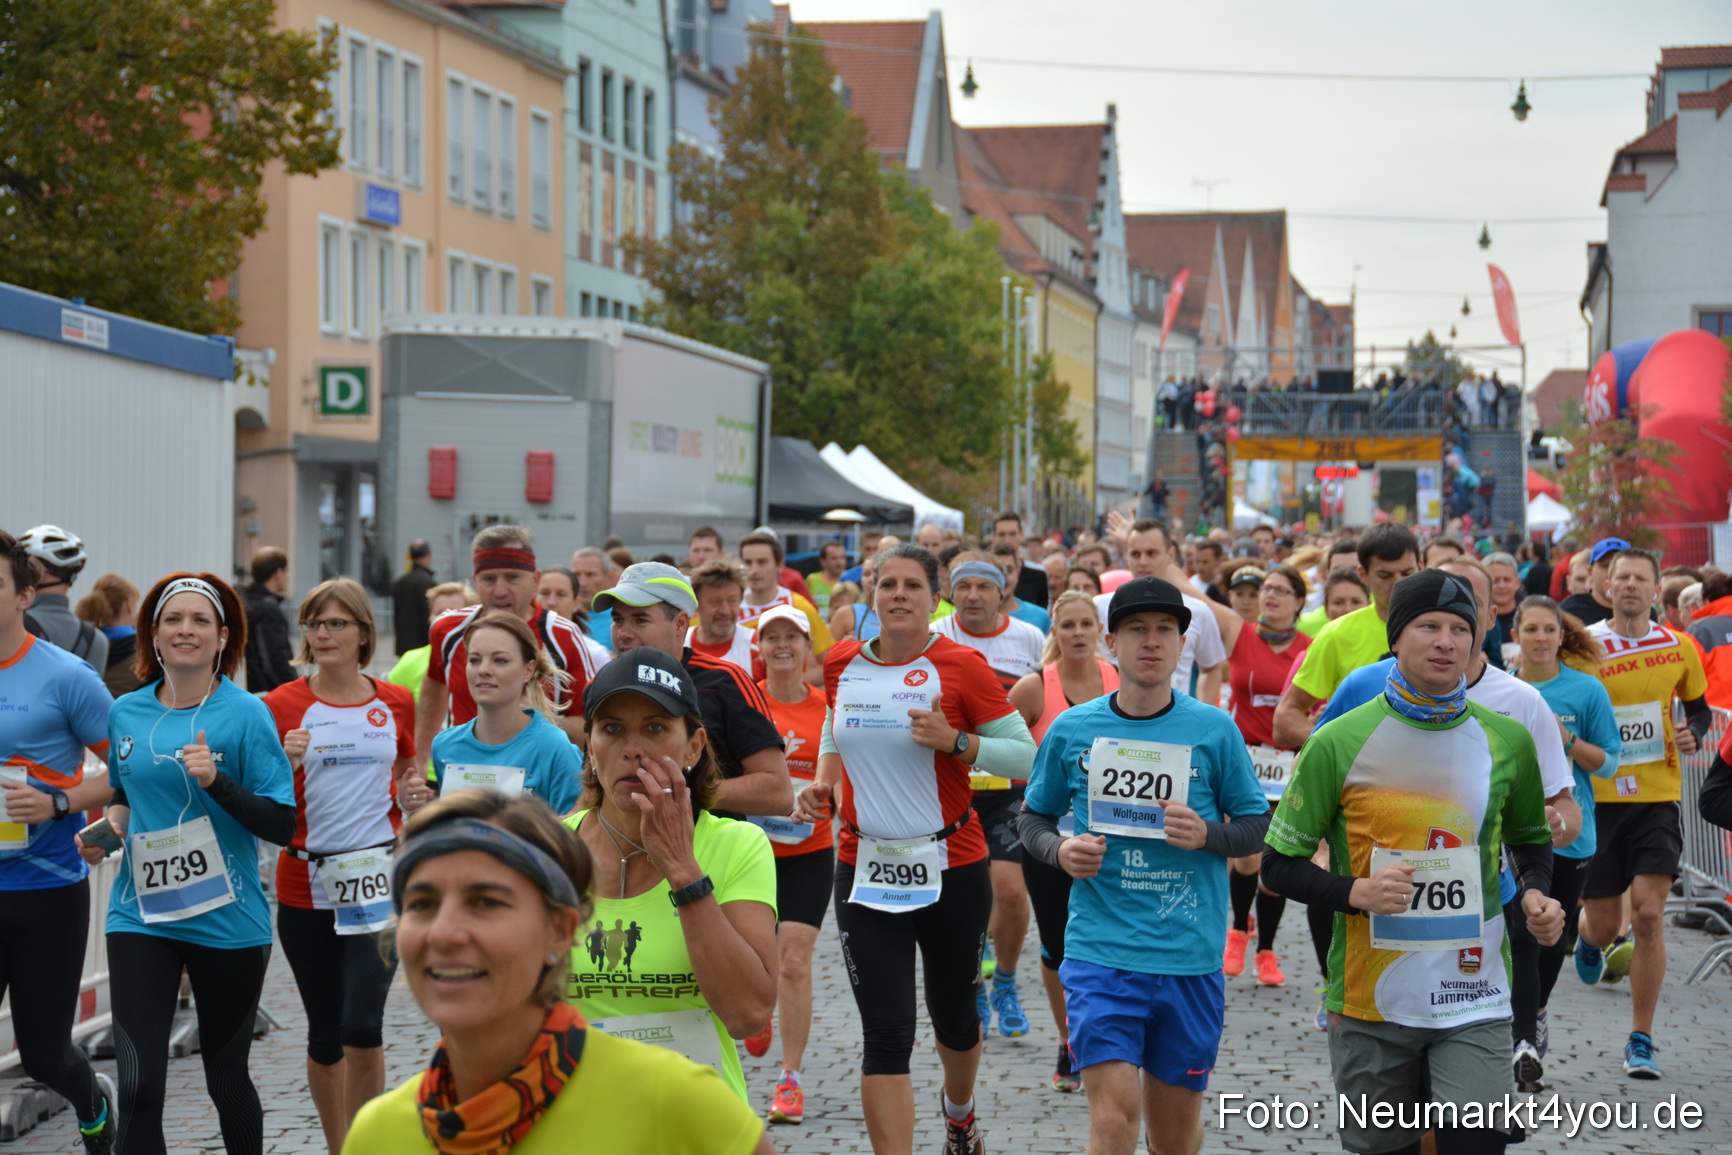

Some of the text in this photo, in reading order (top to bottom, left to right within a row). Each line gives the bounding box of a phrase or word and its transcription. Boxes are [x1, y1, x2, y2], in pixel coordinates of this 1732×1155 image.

[326, 372, 364, 410] D
[1599, 650, 1685, 679] MAX BÖGL
[892, 692, 926, 701] KOPPE
[364, 731, 391, 739] KOPPE
[1620, 721, 1653, 742] 620
[1127, 748, 1162, 761] BOCK
[470, 772, 497, 782] BOCK
[1254, 763, 1284, 782] 040
[1102, 767, 1173, 802] 2320
[1112, 806, 1157, 824] Wolfgang
[1121, 848, 1150, 868] 18.
[1413, 858, 1451, 869] BOCK
[142, 848, 208, 889] 2739
[868, 860, 929, 887] 2599
[1121, 868, 1183, 881] Neumarkter
[335, 872, 391, 904] 2769
[1121, 879, 1171, 893] Stadtlauf
[1410, 879, 1466, 911] 766
[882, 891, 912, 901] Annett
